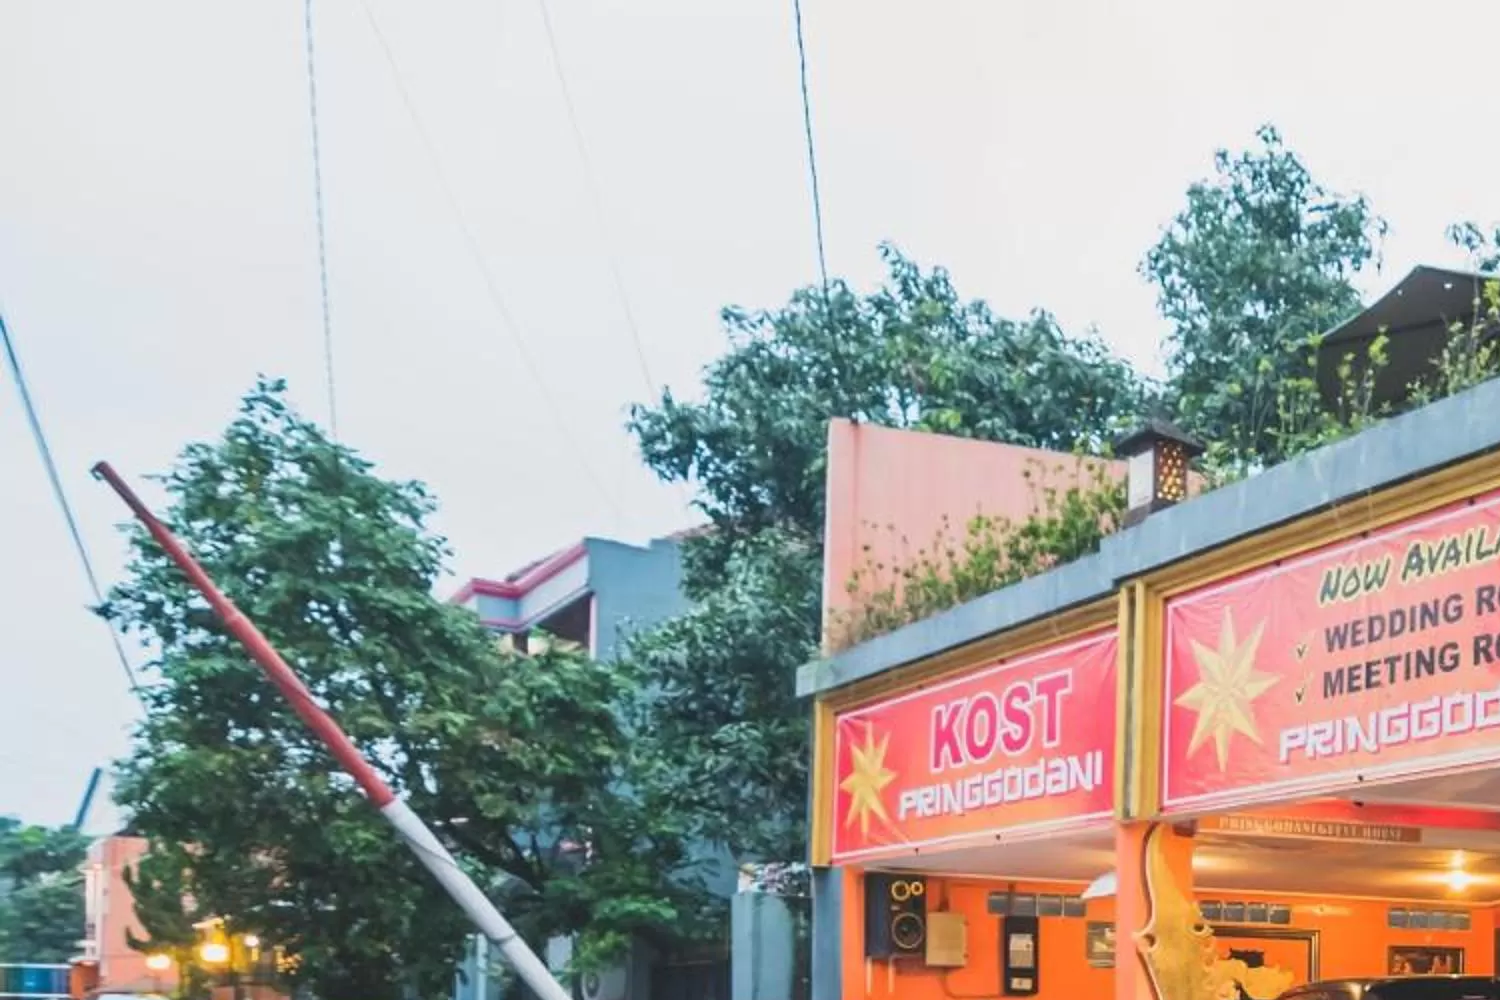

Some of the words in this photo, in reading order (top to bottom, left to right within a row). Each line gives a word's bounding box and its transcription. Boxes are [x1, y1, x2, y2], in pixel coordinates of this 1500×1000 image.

[1318, 556, 1392, 606] NOW
[1325, 594, 1464, 653] WEDDING
[1322, 642, 1460, 699] MEETING
[930, 667, 1073, 774] KOST
